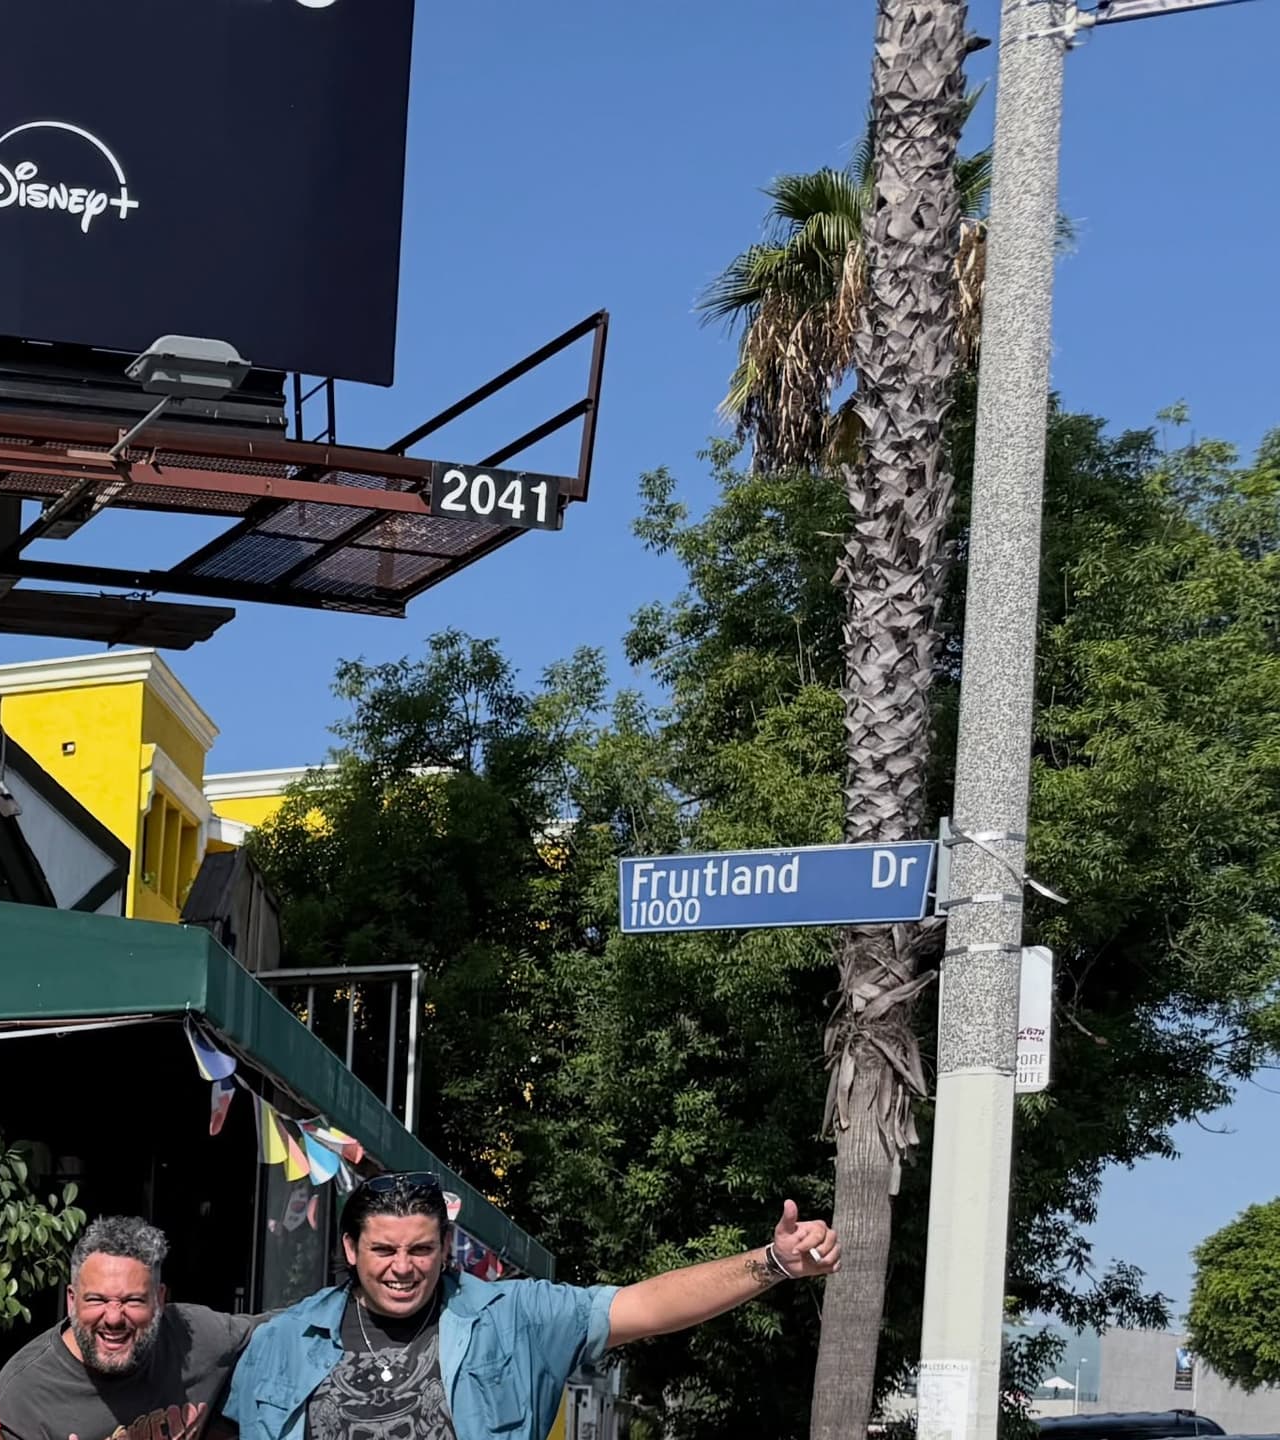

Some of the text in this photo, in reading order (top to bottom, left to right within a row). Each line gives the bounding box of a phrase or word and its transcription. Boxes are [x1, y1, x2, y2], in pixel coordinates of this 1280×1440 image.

[440, 469, 547, 522] 2041
[631, 850, 918, 900] Fruitland Dr
[630, 898, 701, 927] 11000
